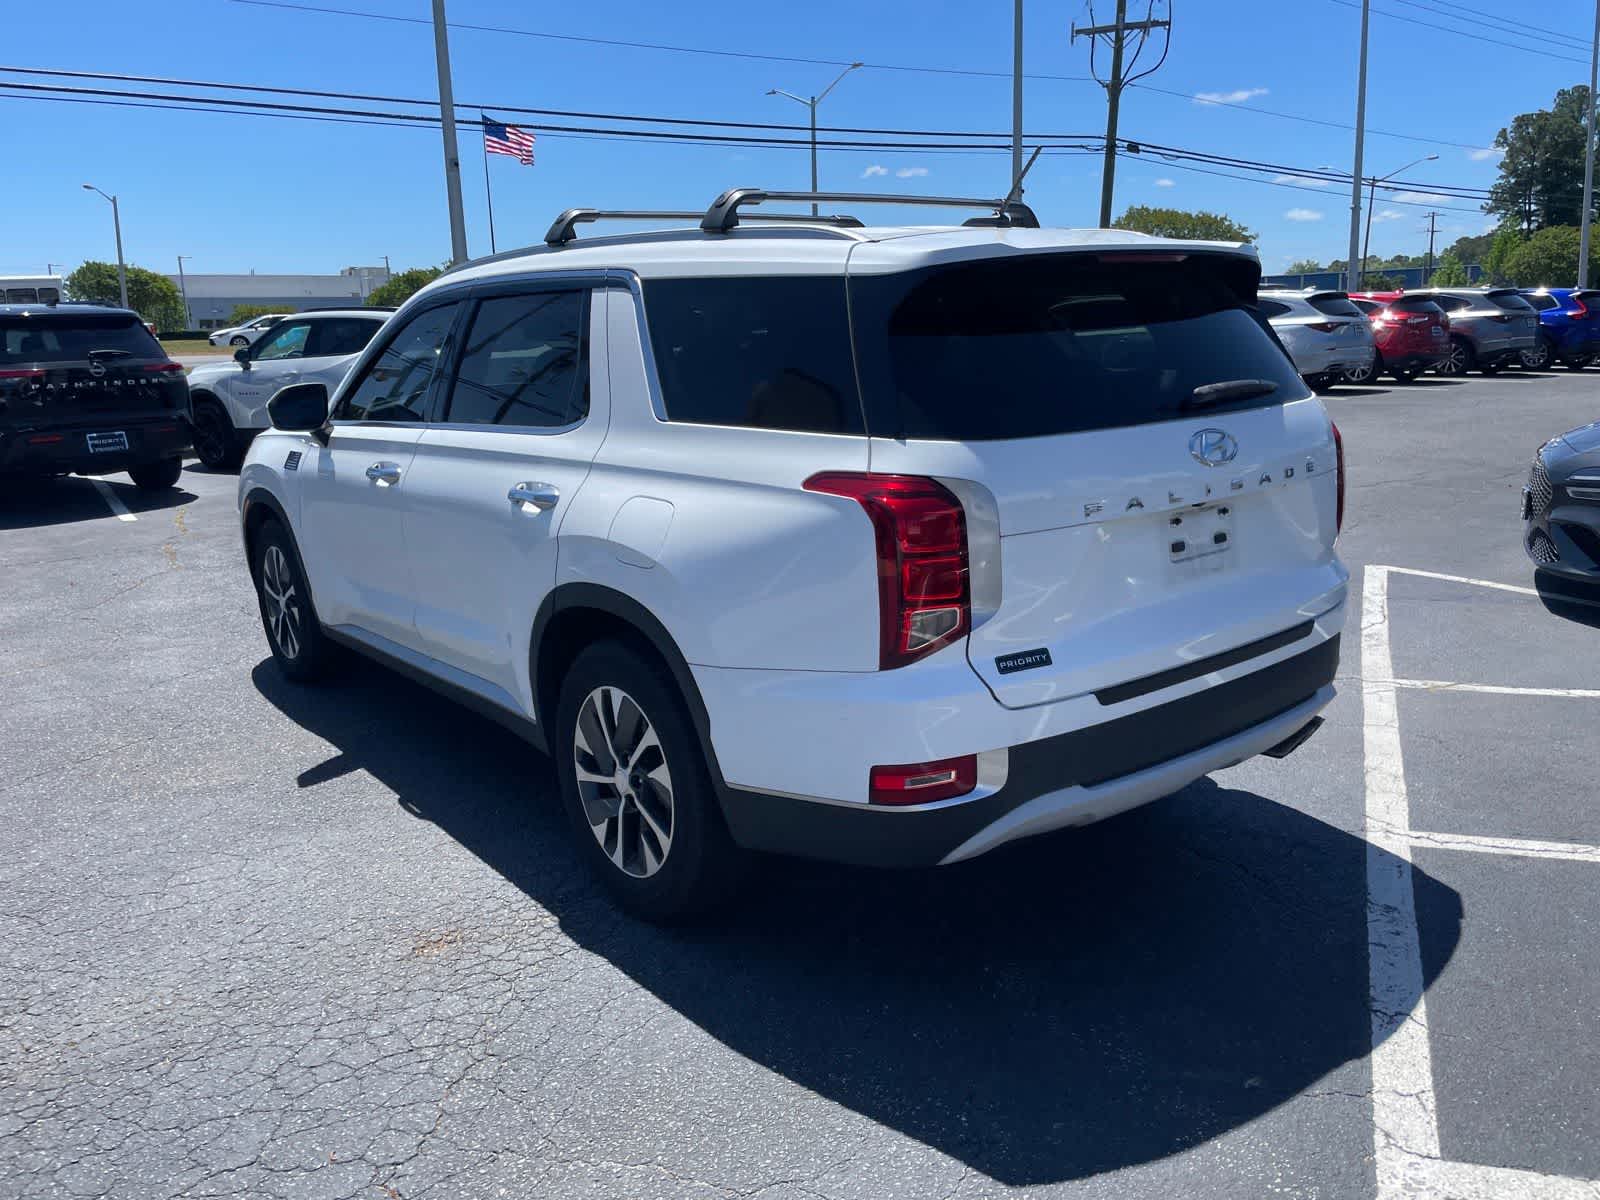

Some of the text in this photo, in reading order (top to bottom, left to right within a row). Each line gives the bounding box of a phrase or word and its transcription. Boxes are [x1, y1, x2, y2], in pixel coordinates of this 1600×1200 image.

[31, 378, 161, 390] PATHFINDER
[1084, 461, 1315, 517] PALISADE
[1000, 654, 1047, 669] PRIORITY
